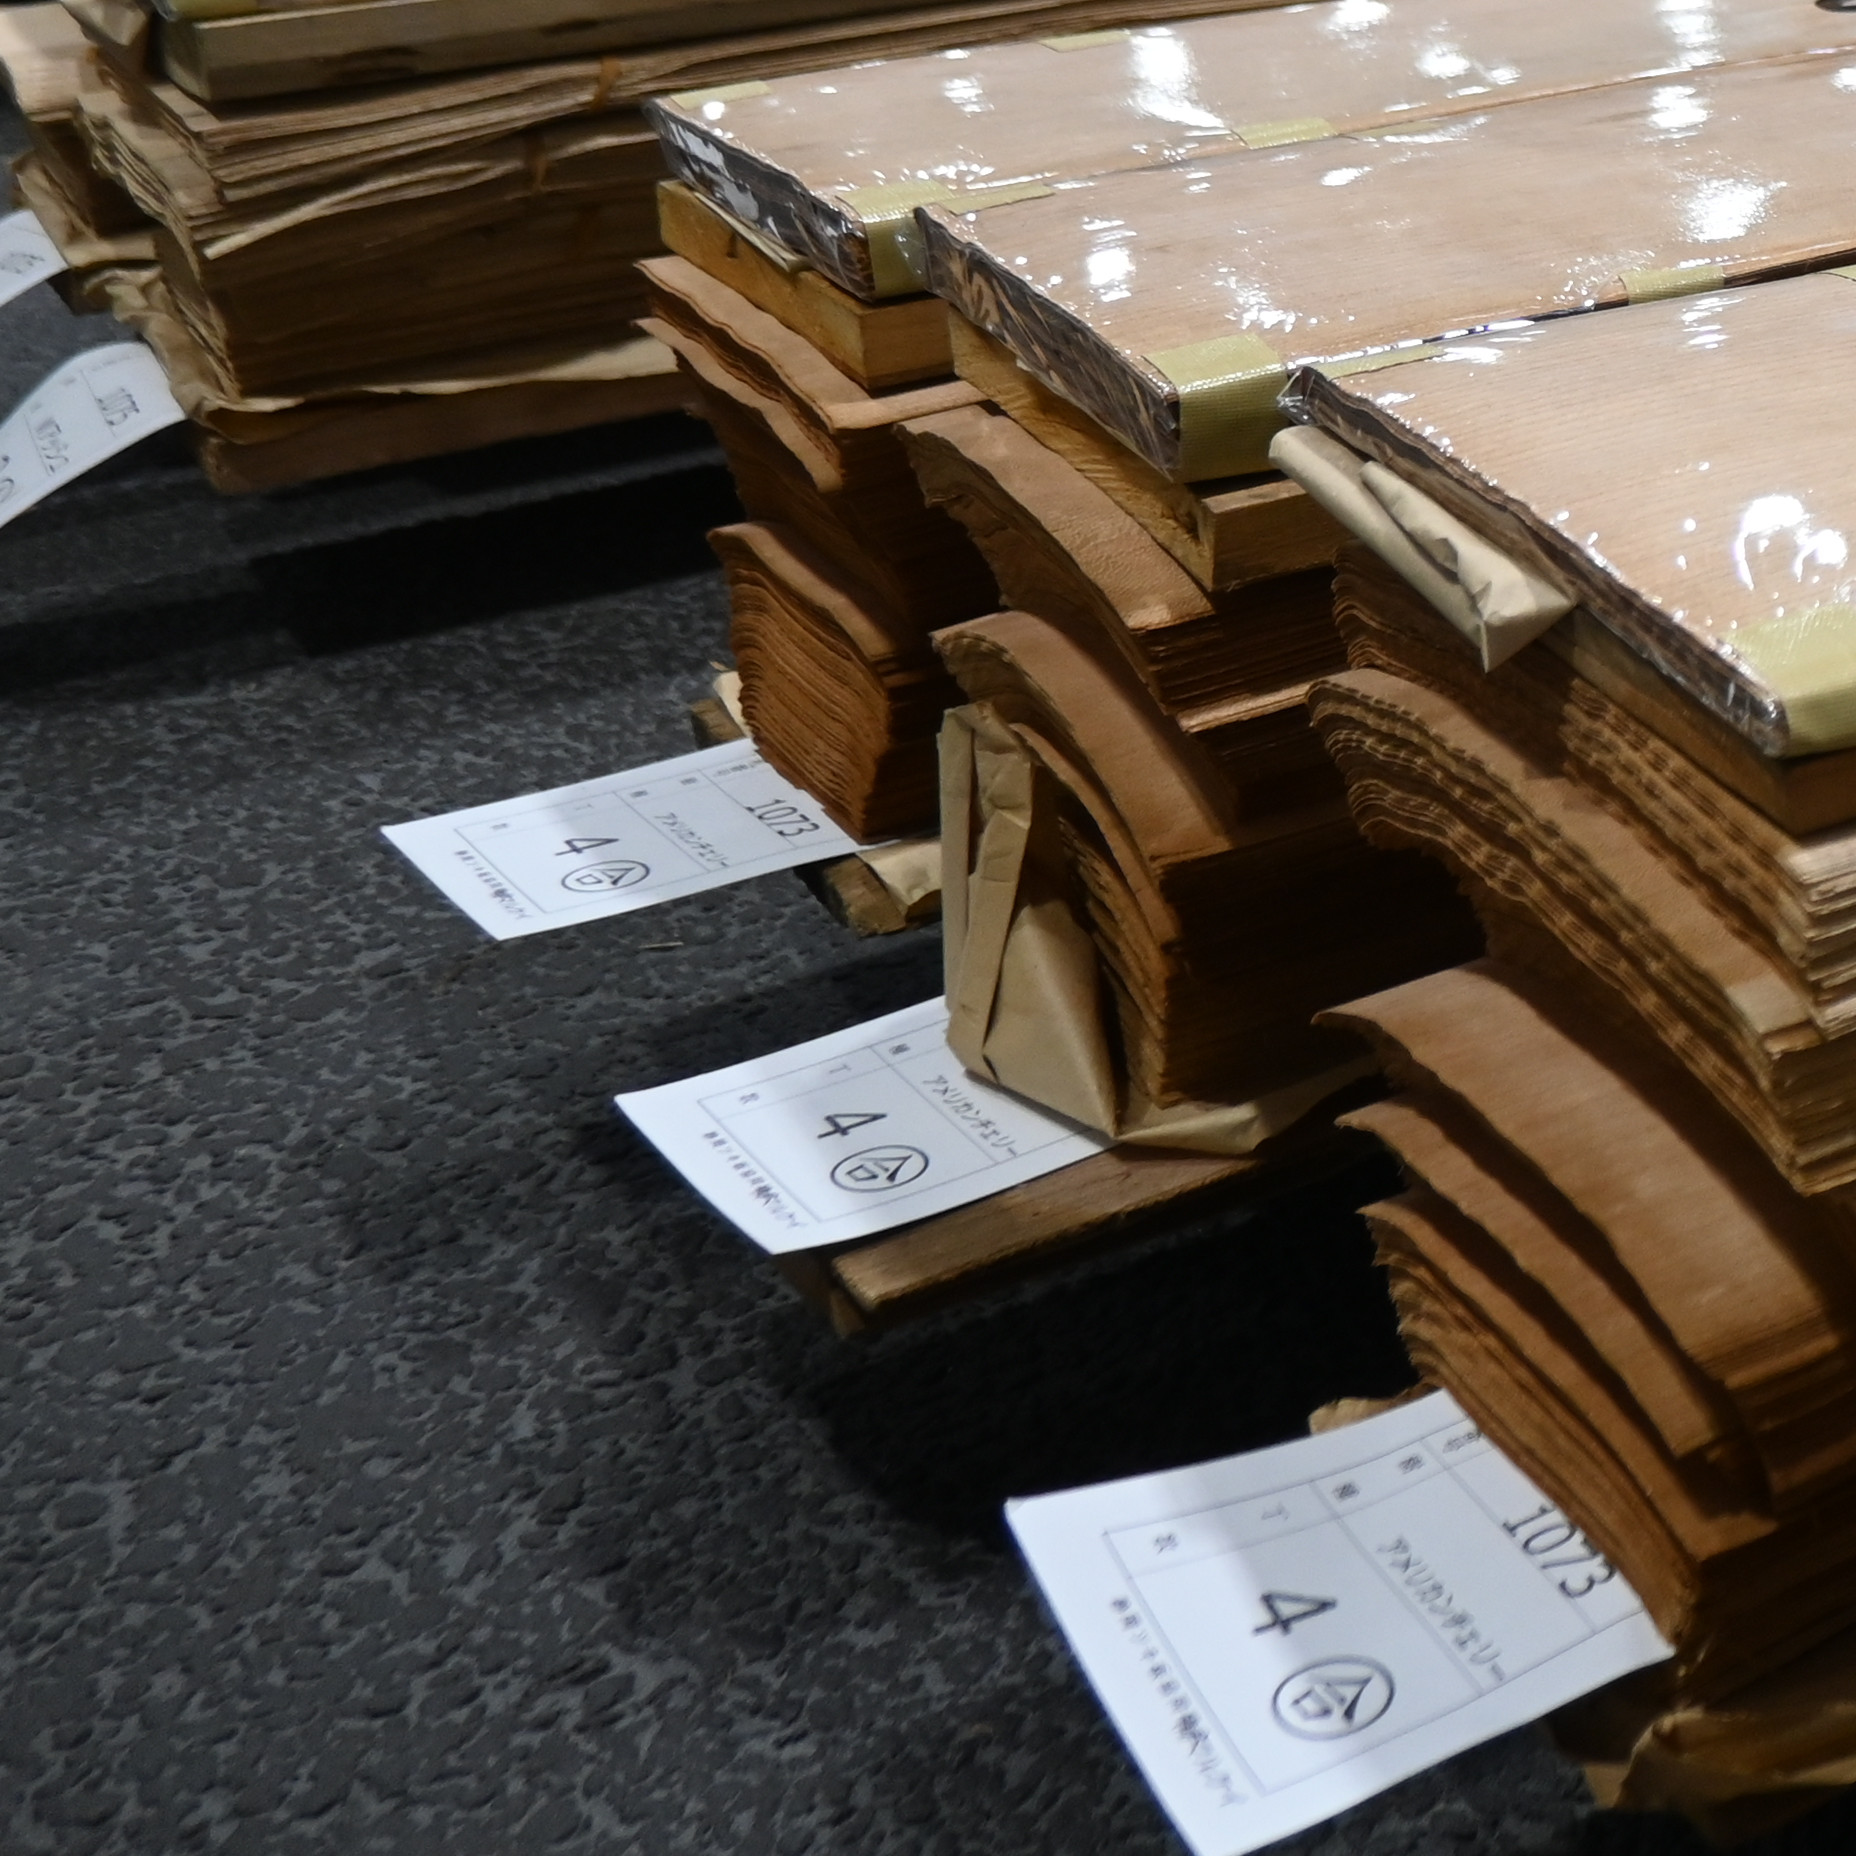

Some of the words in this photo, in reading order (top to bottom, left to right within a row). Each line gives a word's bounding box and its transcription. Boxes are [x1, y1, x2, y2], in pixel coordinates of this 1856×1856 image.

[745, 797, 821, 838] 1073
[554, 837, 621, 856] 4
[817, 1112, 888, 1139] 4
[922, 1074, 1018, 1158] アメリカンチェリー
[1502, 1503, 1617, 1600] 1073
[1253, 1590, 1338, 1635] 4
